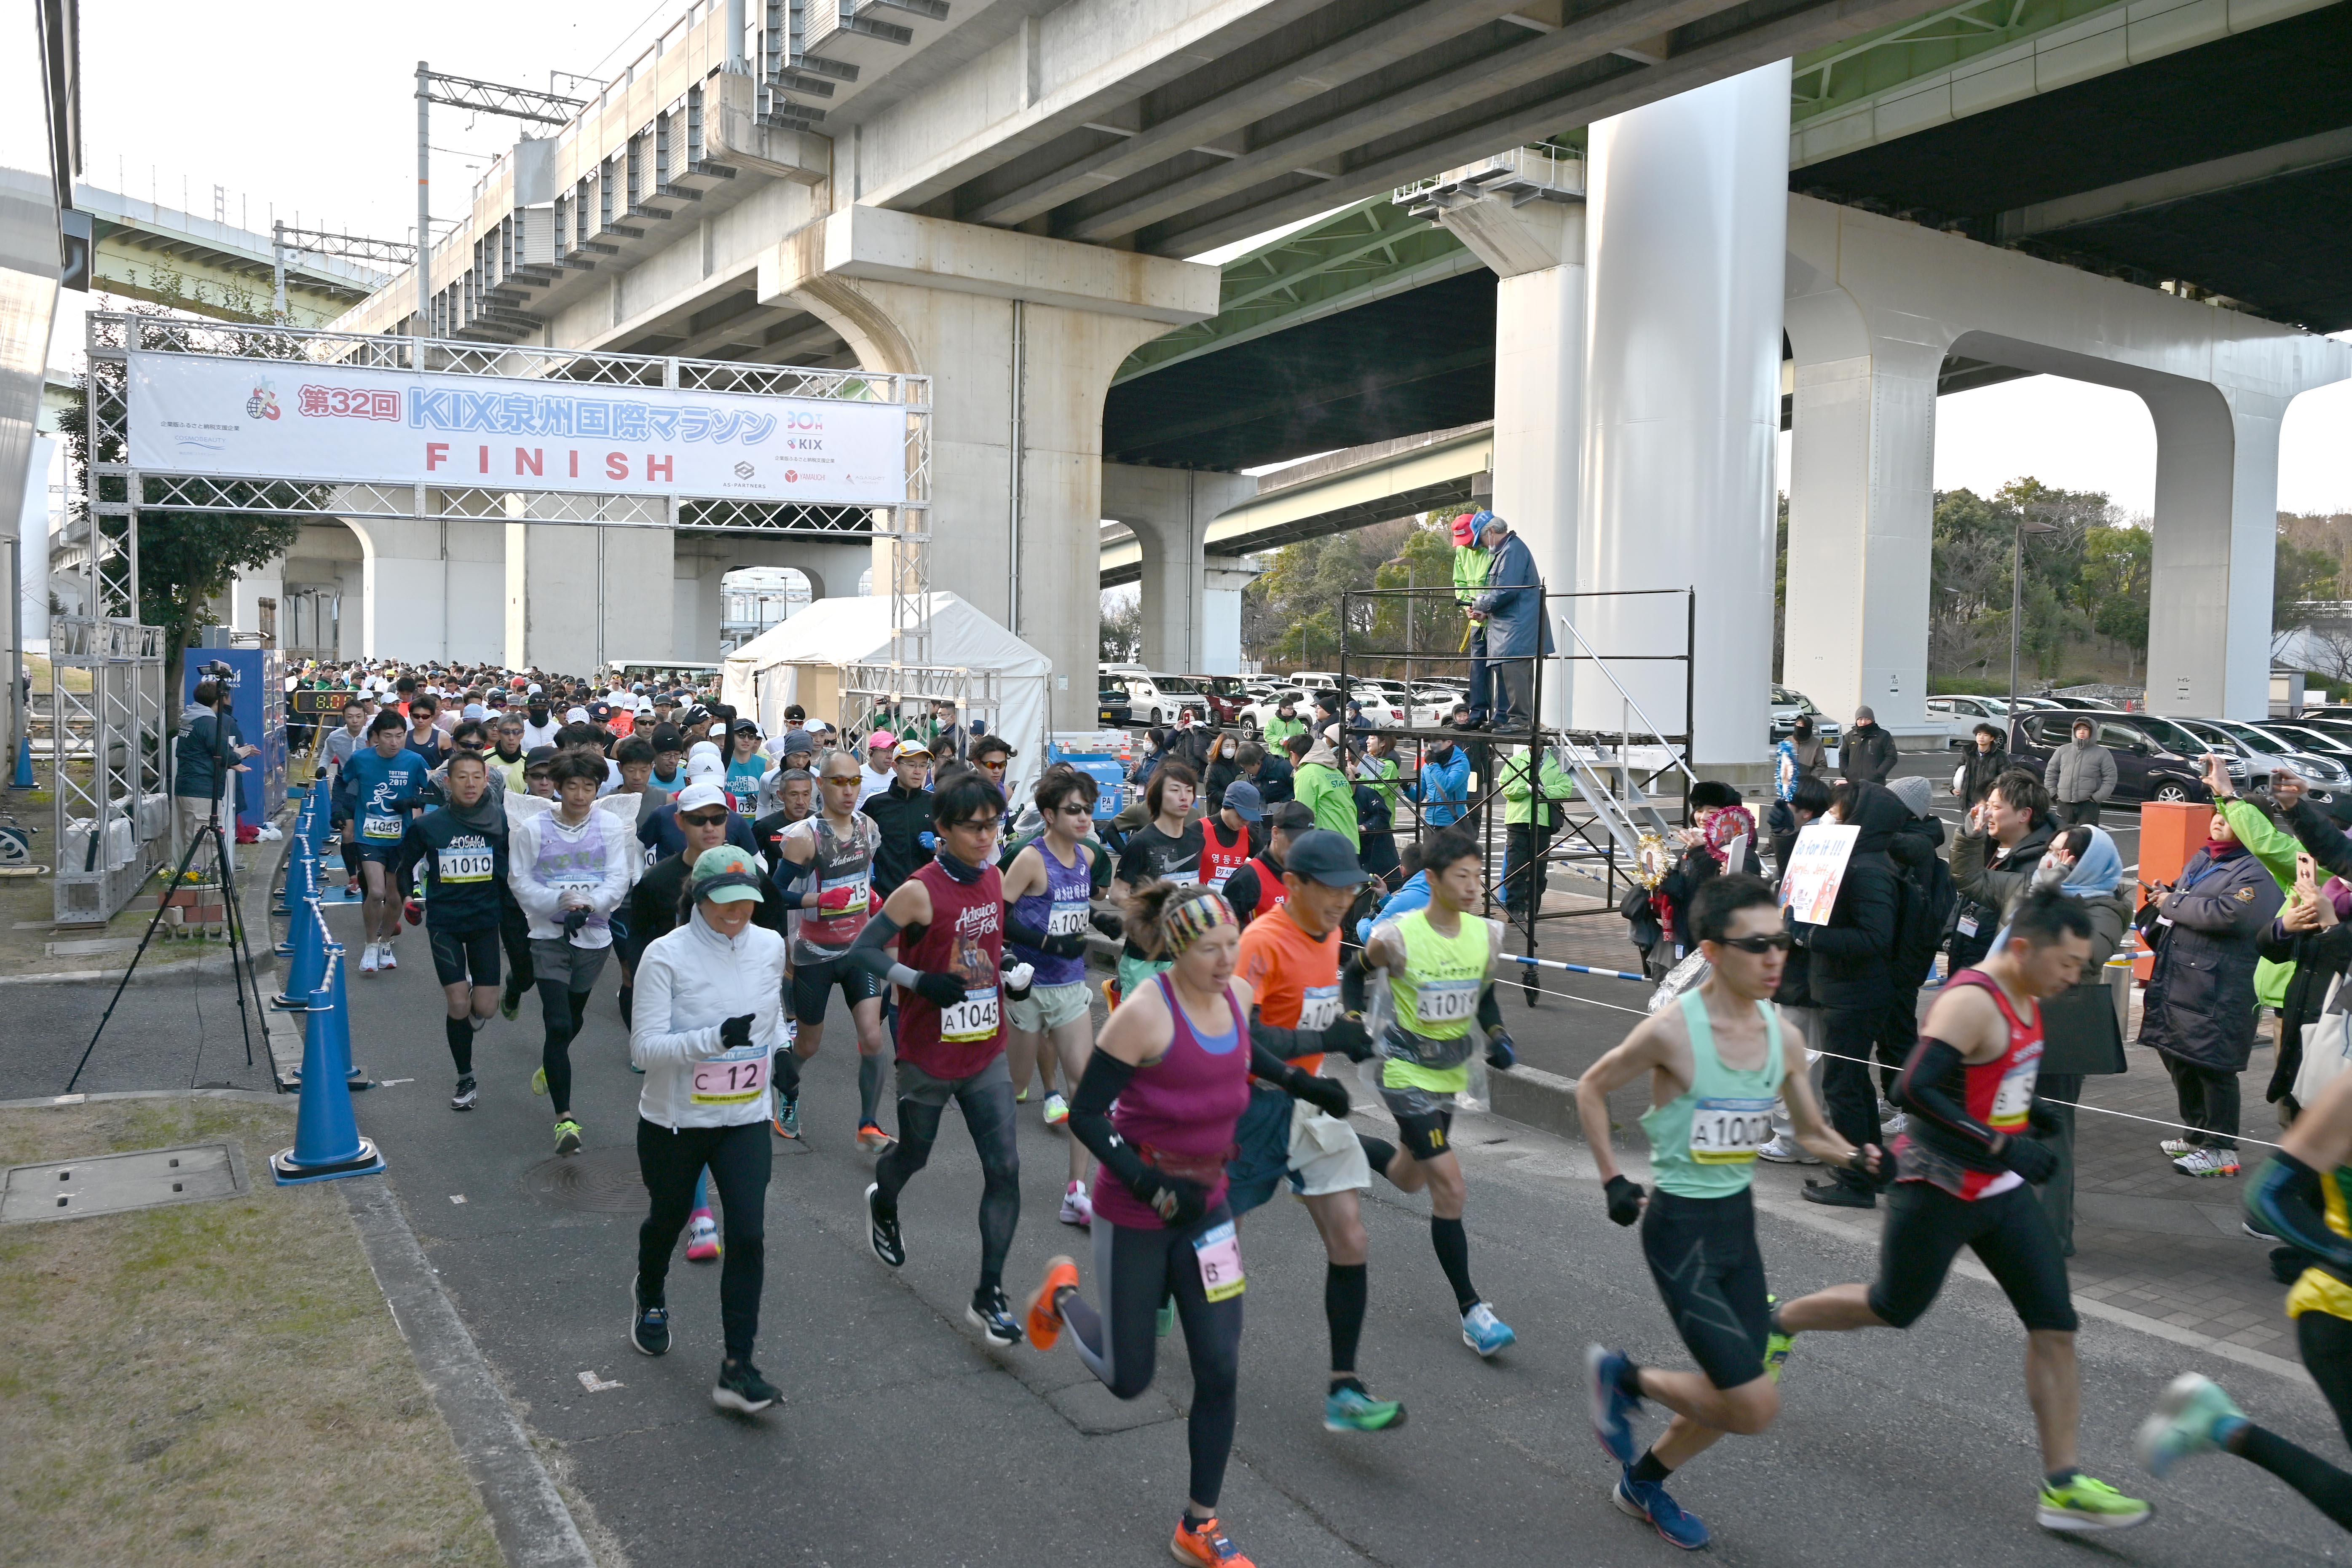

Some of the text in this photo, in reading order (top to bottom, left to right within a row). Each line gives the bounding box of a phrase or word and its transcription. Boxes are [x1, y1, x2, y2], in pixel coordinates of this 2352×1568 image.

[298, 384, 777, 446] 第32回 KIX泉州国際マラソン
[161, 421, 240, 431] 企業版ふるさと納税支援企業
[175, 435, 226, 443] COSMOBEAUTY
[799, 439, 822, 450] KIX
[426, 442, 673, 482] FINISH
[775, 456, 835, 464] 企業版ふるさと納税支援企業
[373, 821, 400, 832] 1049
[458, 835, 486, 849] OSAKA
[1796, 840, 1805, 855] Go
[1806, 839, 1820, 855] for
[441, 857, 490, 874] A 1010
[829, 853, 864, 868] Hakusan
[954, 902, 998, 932] Advice
[1049, 920, 1058, 932] A
[944, 1002, 997, 1030] A 1045
[1419, 1001, 1430, 1016] A
[695, 1064, 758, 1090] C 12
[1693, 1125, 1709, 1145] A
[1205, 1263, 1219, 1282] B
